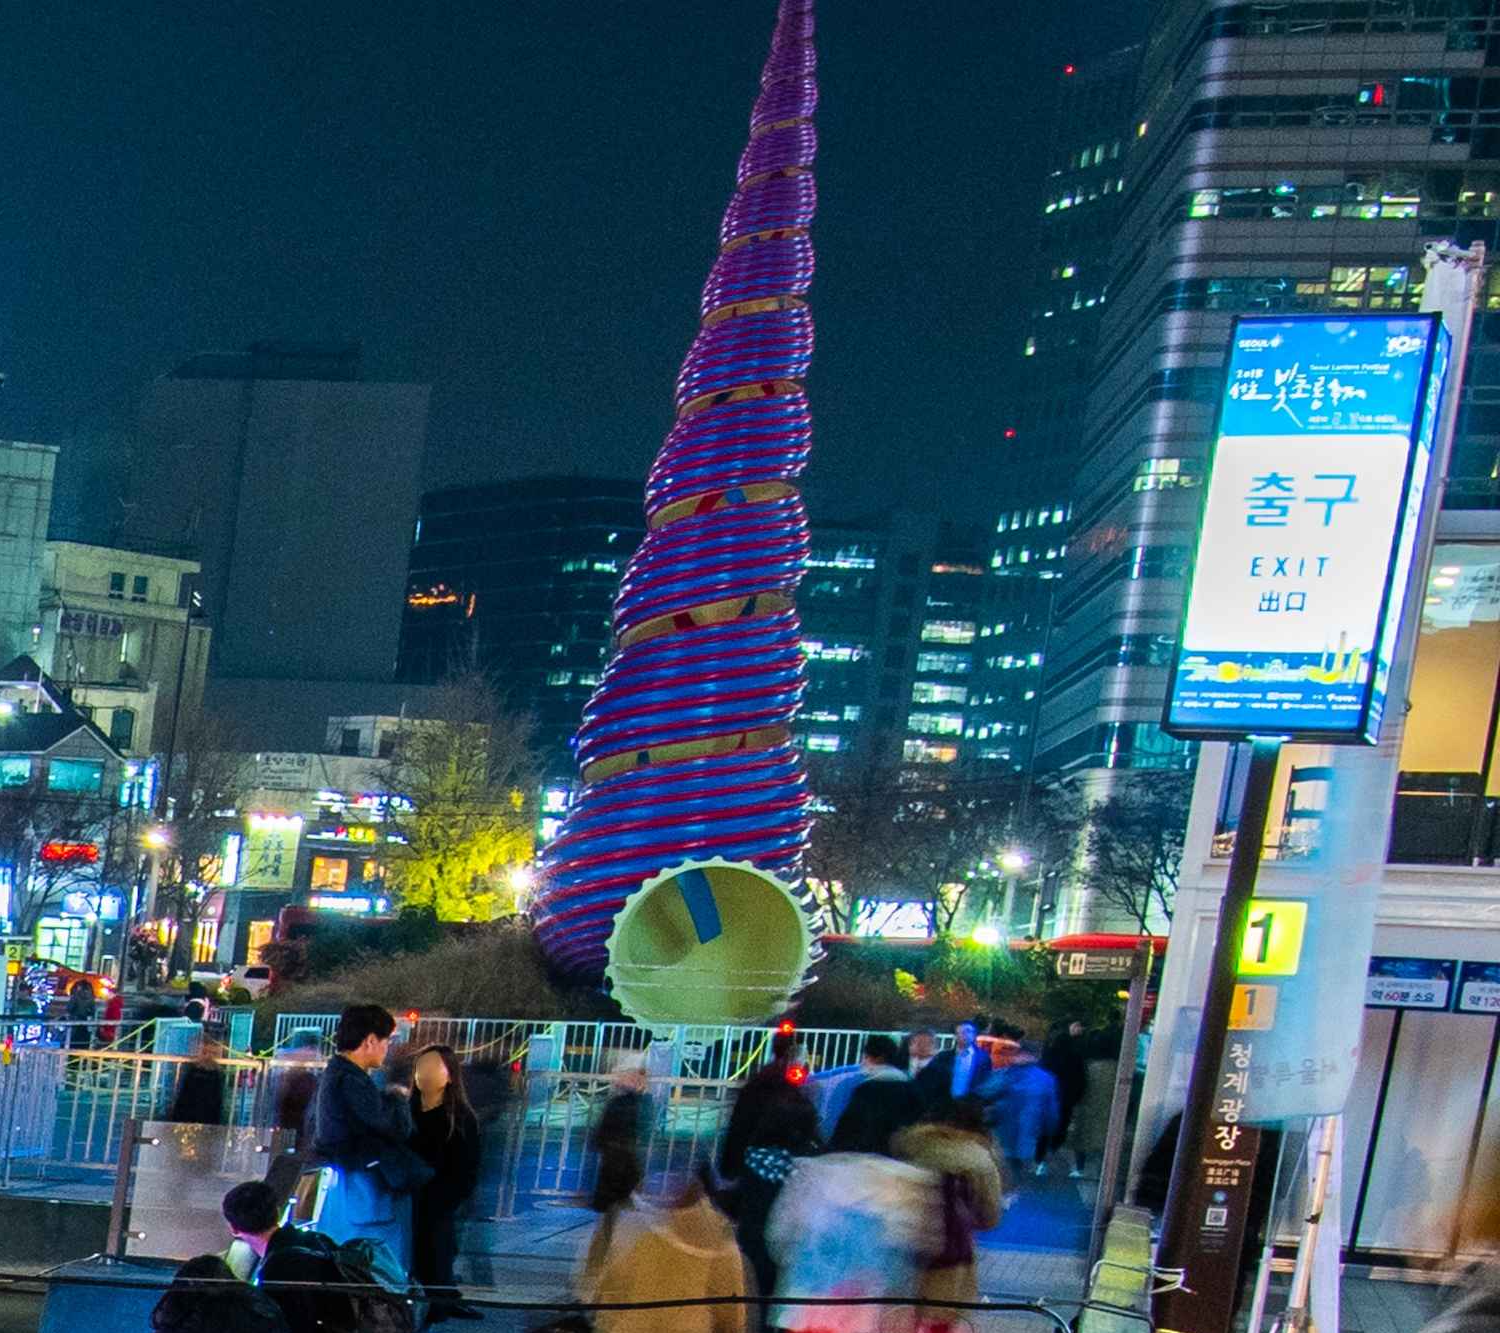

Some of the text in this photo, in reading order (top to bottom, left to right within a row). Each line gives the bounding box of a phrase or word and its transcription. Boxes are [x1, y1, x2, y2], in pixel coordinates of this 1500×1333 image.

[1243, 472, 1360, 527] 출구
[1250, 557, 1330, 577] EXIT
[1258, 590, 1307, 612] 出口
[1251, 912, 1274, 964] 1
[9, 946, 18, 959] 2
[1244, 989, 1258, 1015] 1
[1214, 1044, 1253, 1150] 청계광장
